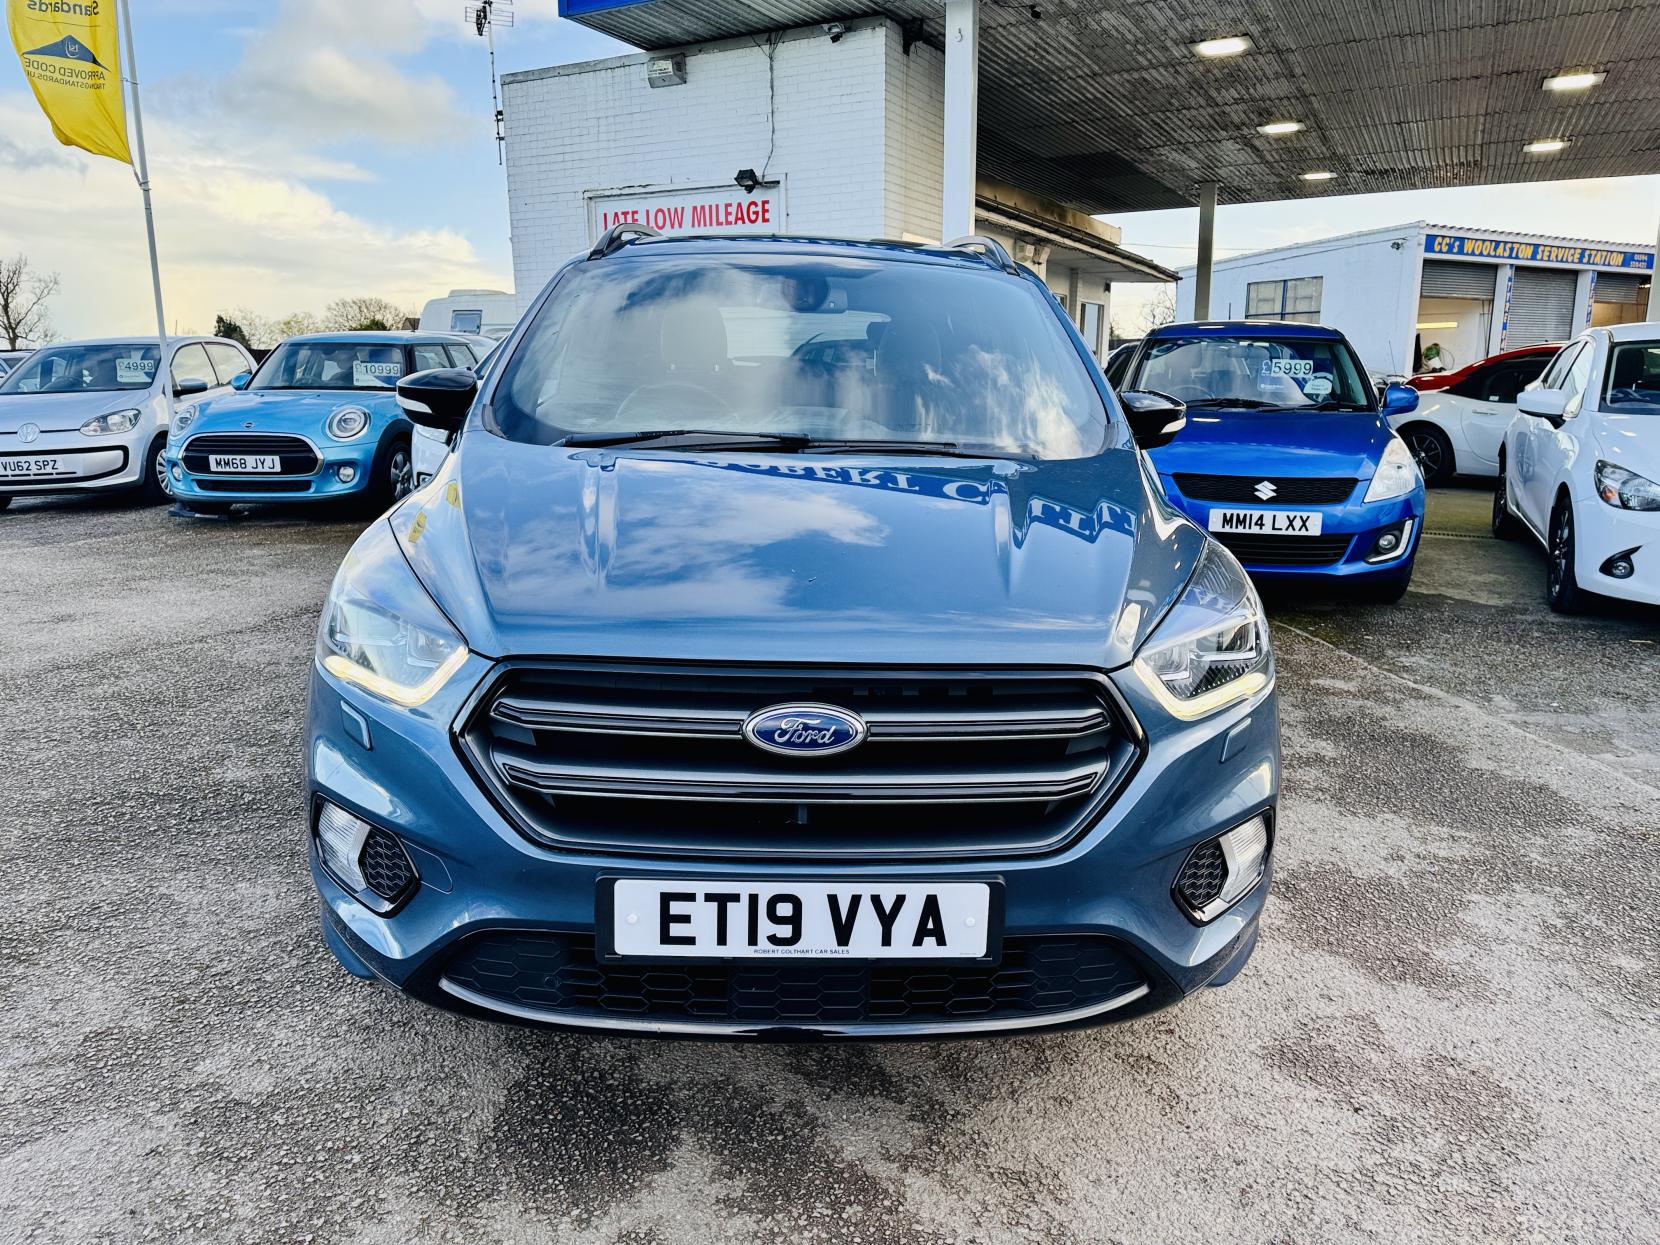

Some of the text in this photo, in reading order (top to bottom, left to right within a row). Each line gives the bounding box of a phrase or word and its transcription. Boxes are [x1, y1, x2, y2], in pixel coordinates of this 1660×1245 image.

[646, 206, 685, 231] LOW
[691, 200, 770, 228] MILEAGE
[1463, 239, 1534, 259] WOOLASTON
[1536, 245, 1582, 264] SERVICE
[1582, 249, 1624, 267] STATION
[1261, 360, 1312, 375] £5999
[0, 459, 59, 472] VU62 SPZ
[214, 457, 275, 470] MM68 JYJ
[1221, 512, 1310, 532] MM14 LXX
[774, 717, 837, 744] Ford
[659, 891, 948, 948] ET19 VYA
